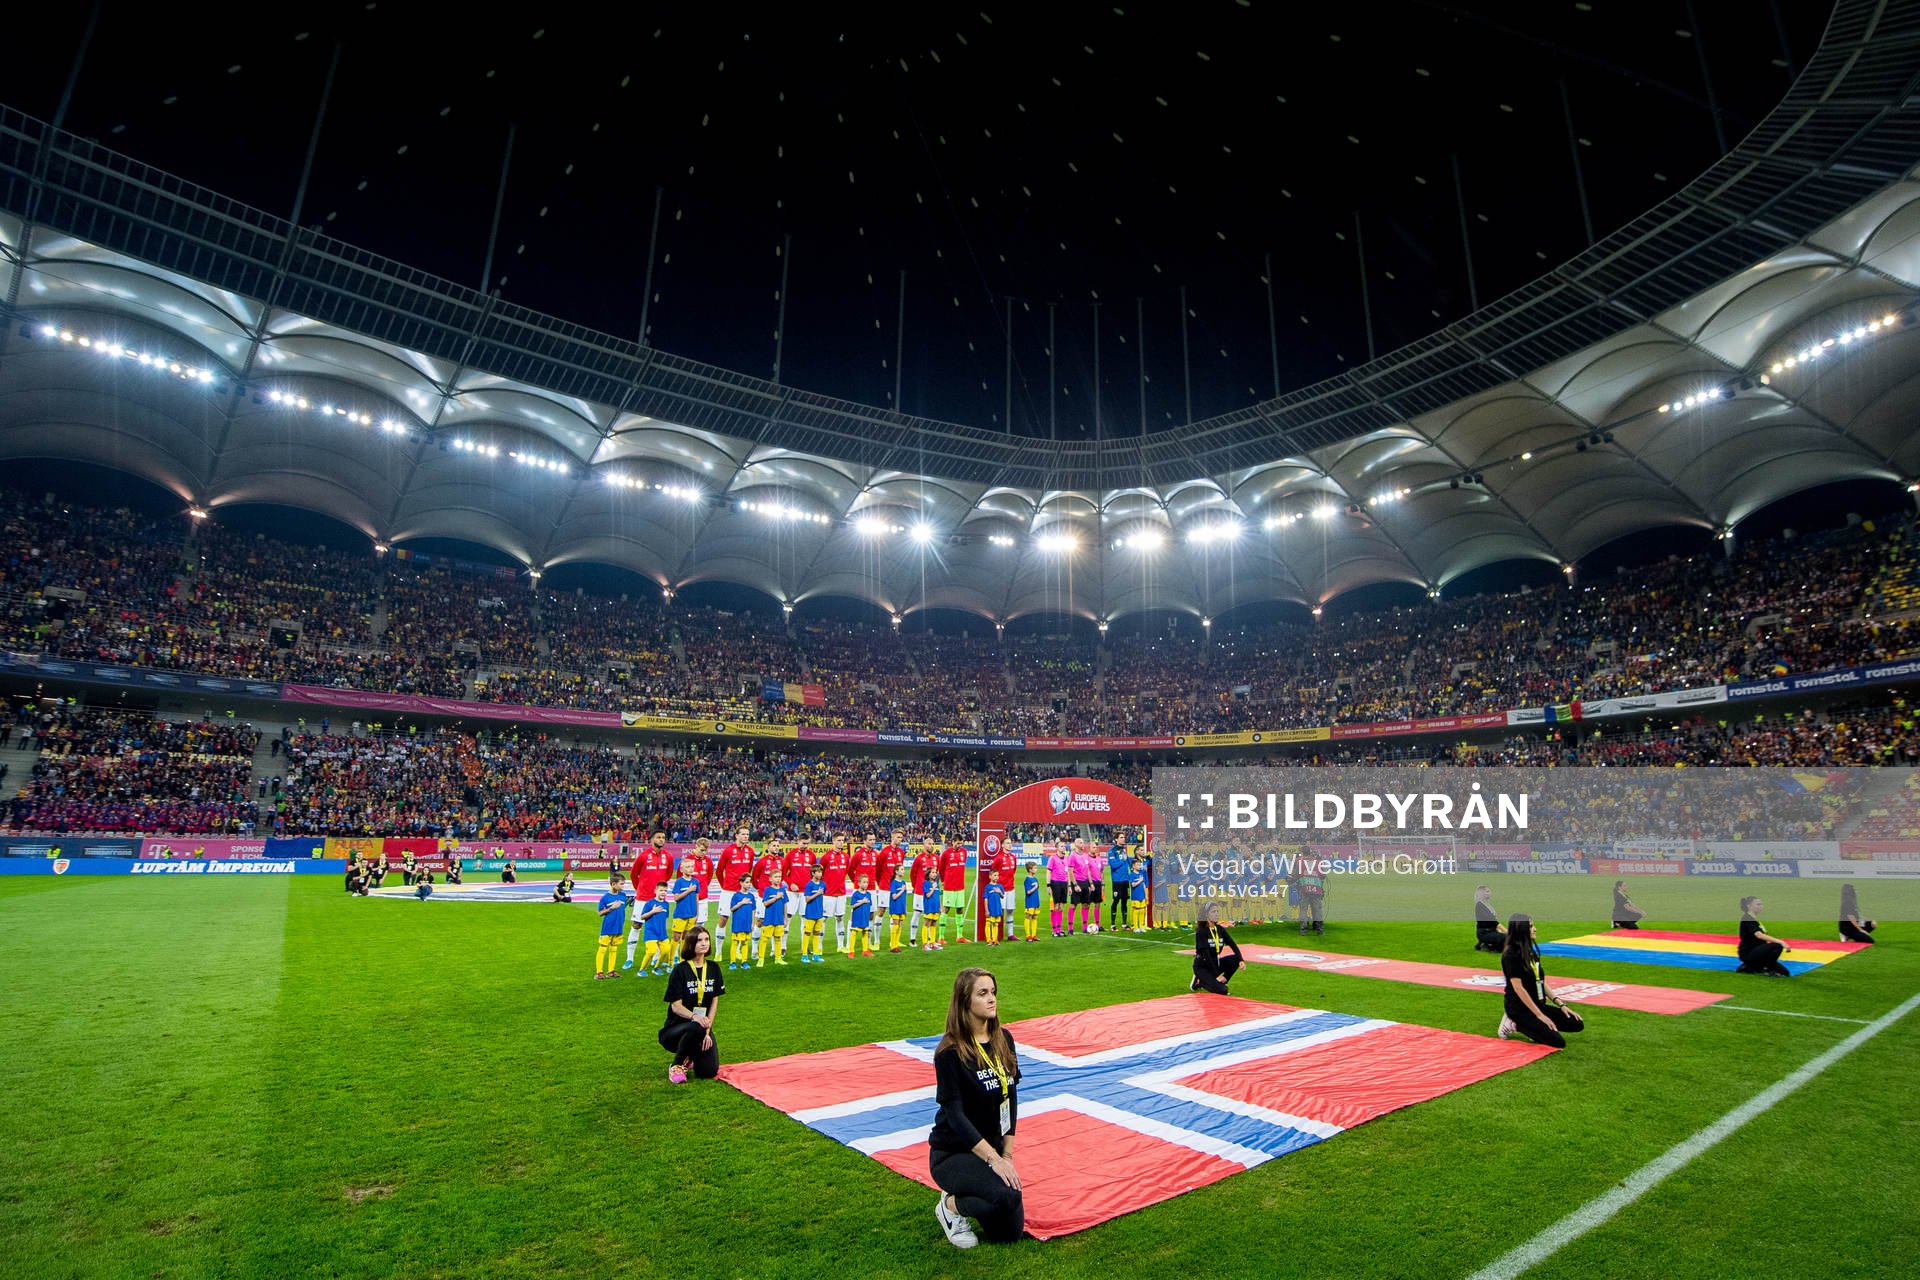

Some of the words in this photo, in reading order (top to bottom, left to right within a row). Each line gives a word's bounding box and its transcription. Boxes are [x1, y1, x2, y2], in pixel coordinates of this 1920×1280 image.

[1075, 794, 1106, 802] EUROPEAN
[1071, 801, 1110, 811] QUALIFIERS
[231, 845, 265, 853] SPONSO
[130, 861, 206, 873] LUPTĂM
[206, 860, 295, 873] ÎMPREUNĂ
[976, 1069, 989, 1081] BE
[983, 1078, 1000, 1091] THE
